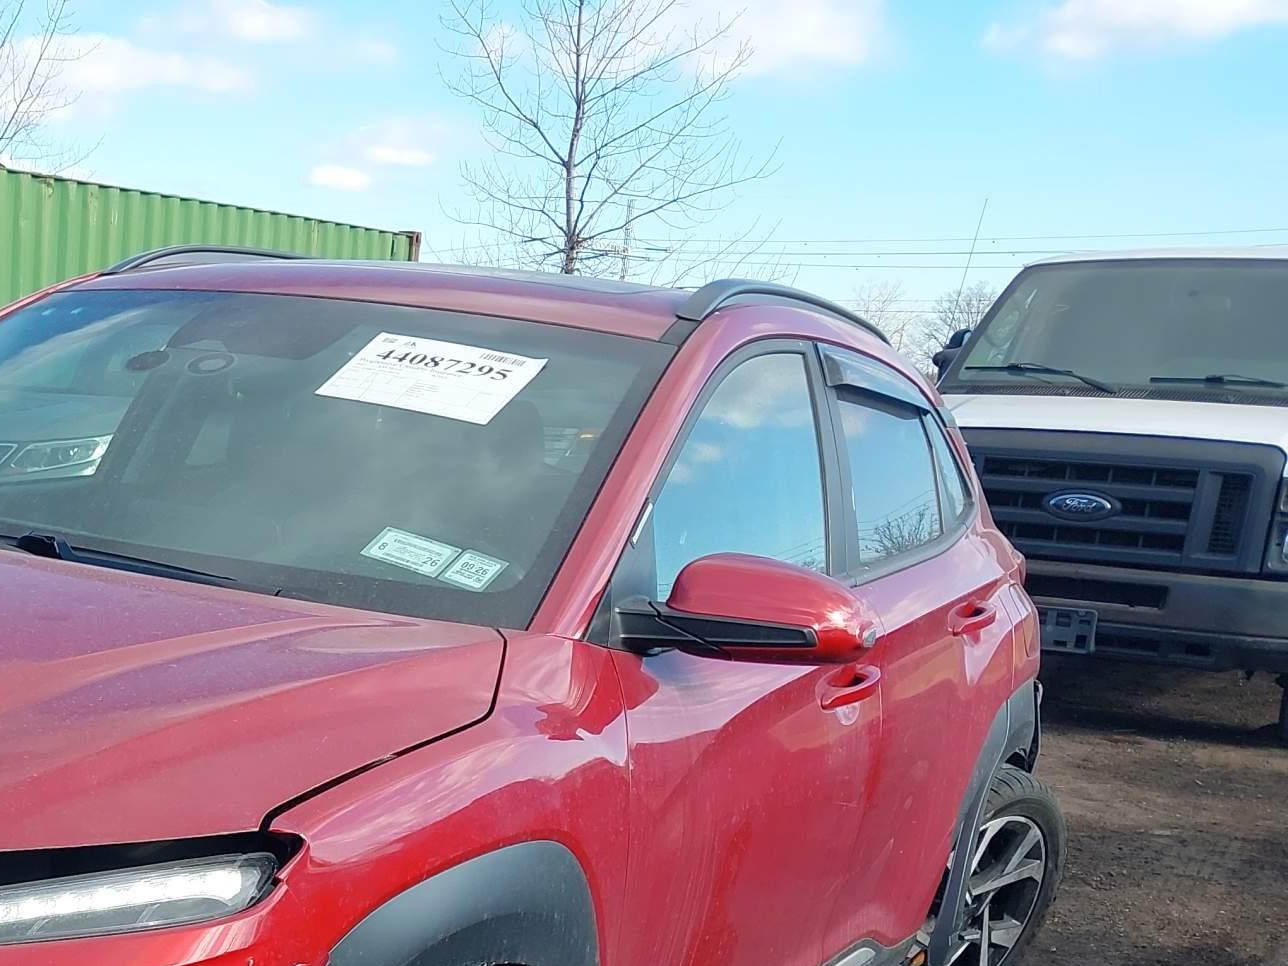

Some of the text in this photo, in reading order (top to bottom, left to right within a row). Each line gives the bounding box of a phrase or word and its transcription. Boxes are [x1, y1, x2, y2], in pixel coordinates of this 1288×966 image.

[375, 349, 513, 381] 44087295
[1062, 497, 1098, 513] Ford
[421, 556, 441, 567] 26
